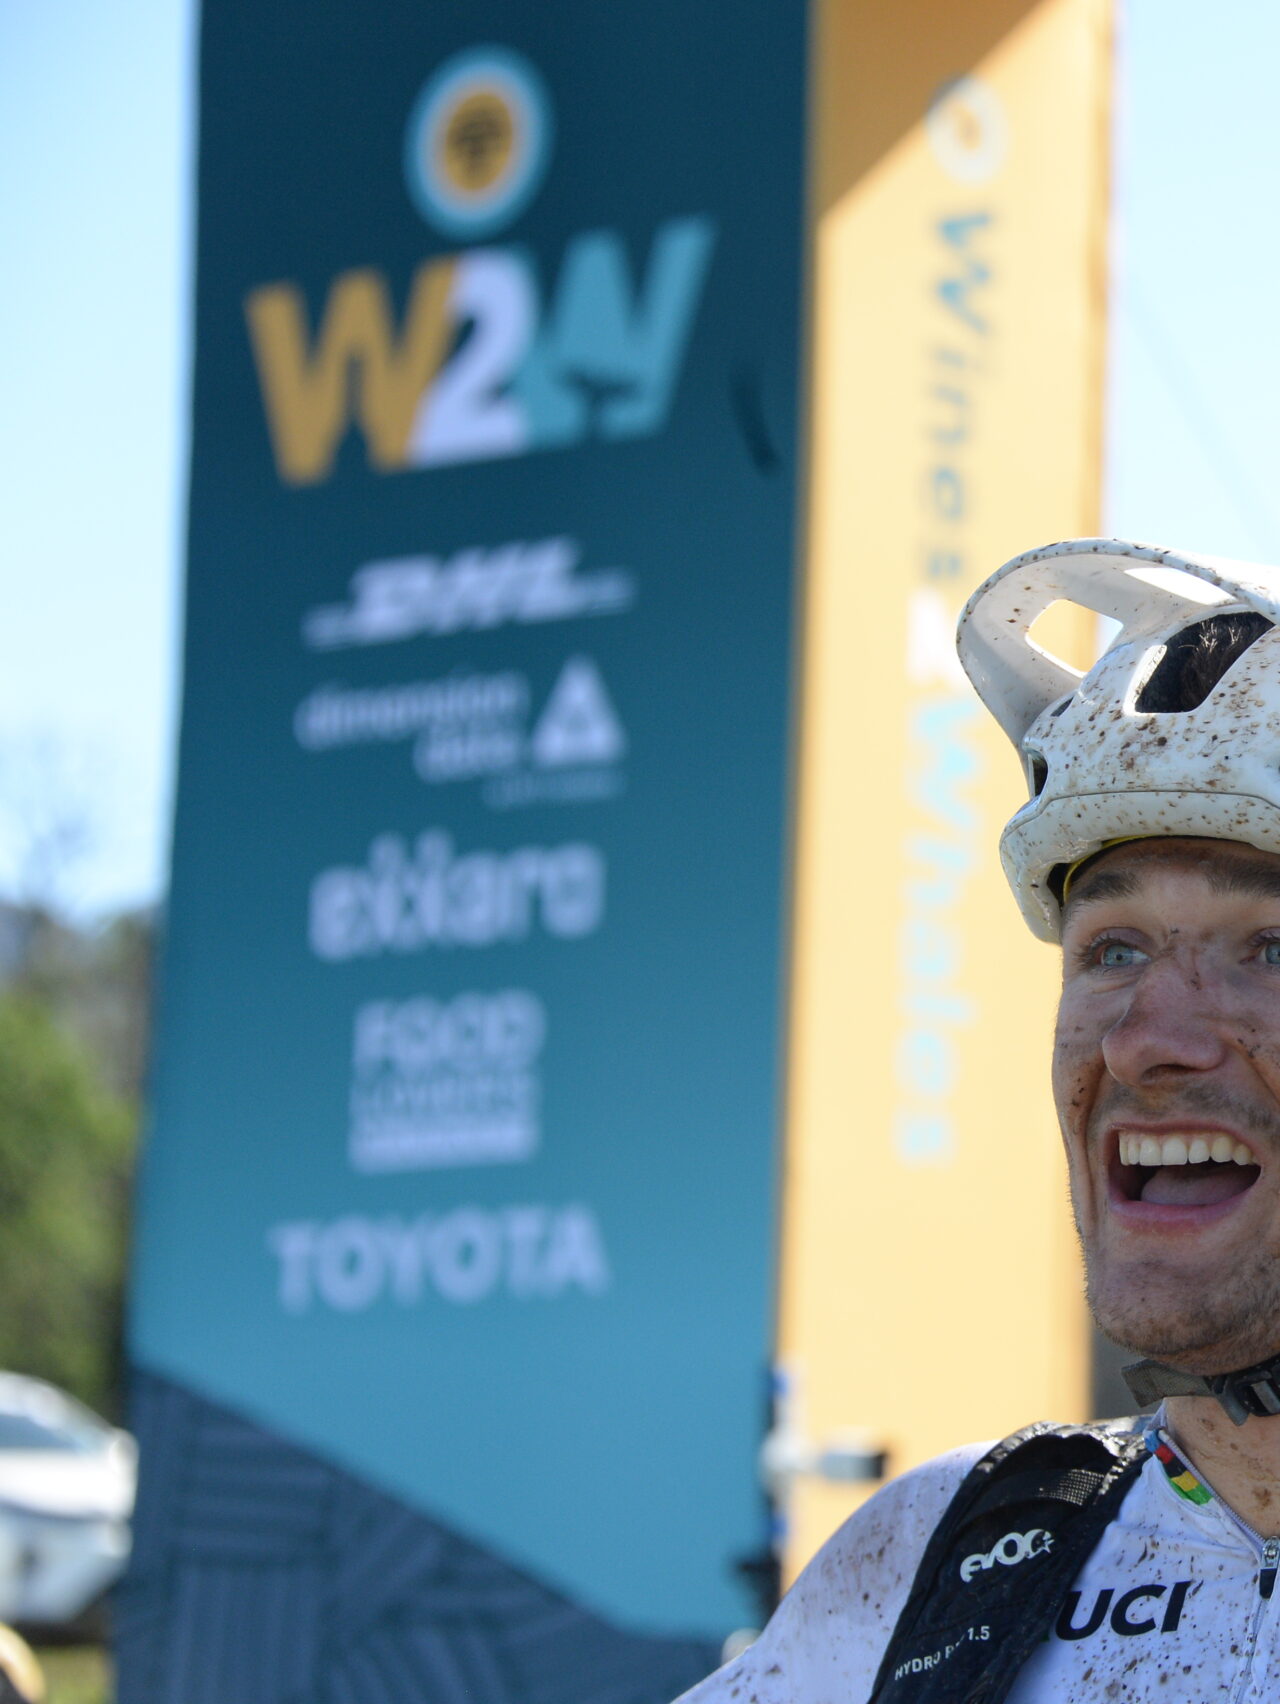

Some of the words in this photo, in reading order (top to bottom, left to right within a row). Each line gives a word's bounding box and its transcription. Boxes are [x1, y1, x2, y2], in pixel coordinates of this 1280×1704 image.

[246, 215, 715, 486] W2W
[270, 1207, 611, 1312] TOYOTA
[967, 1625, 990, 1640] 1.5
[1056, 1580, 1193, 1641] UCI
